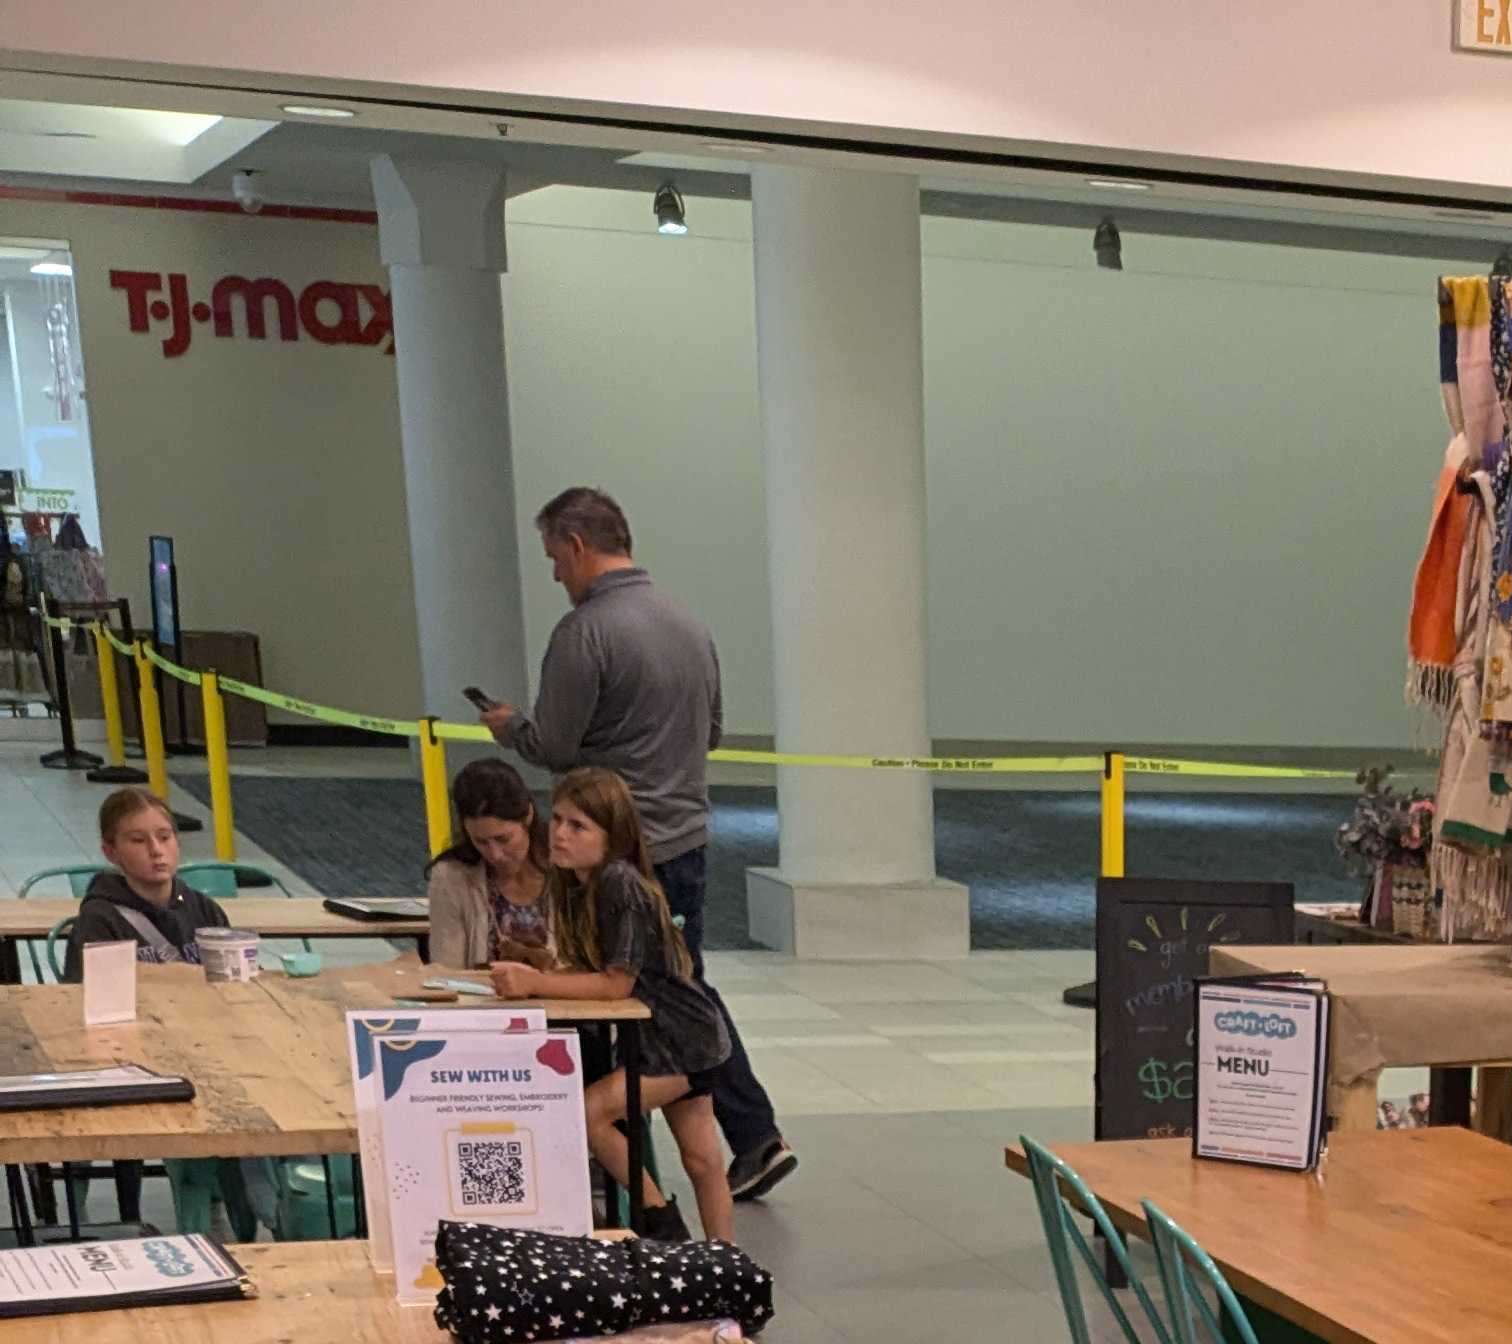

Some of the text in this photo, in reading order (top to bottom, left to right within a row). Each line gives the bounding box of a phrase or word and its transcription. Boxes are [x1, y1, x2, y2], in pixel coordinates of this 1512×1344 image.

[1217, 1055, 1270, 1077] MENU
[430, 1069, 532, 1083] SEW WITH US
[450, 1094, 484, 1103] FRIENDLY
[455, 1105, 492, 1113] WEAVING
